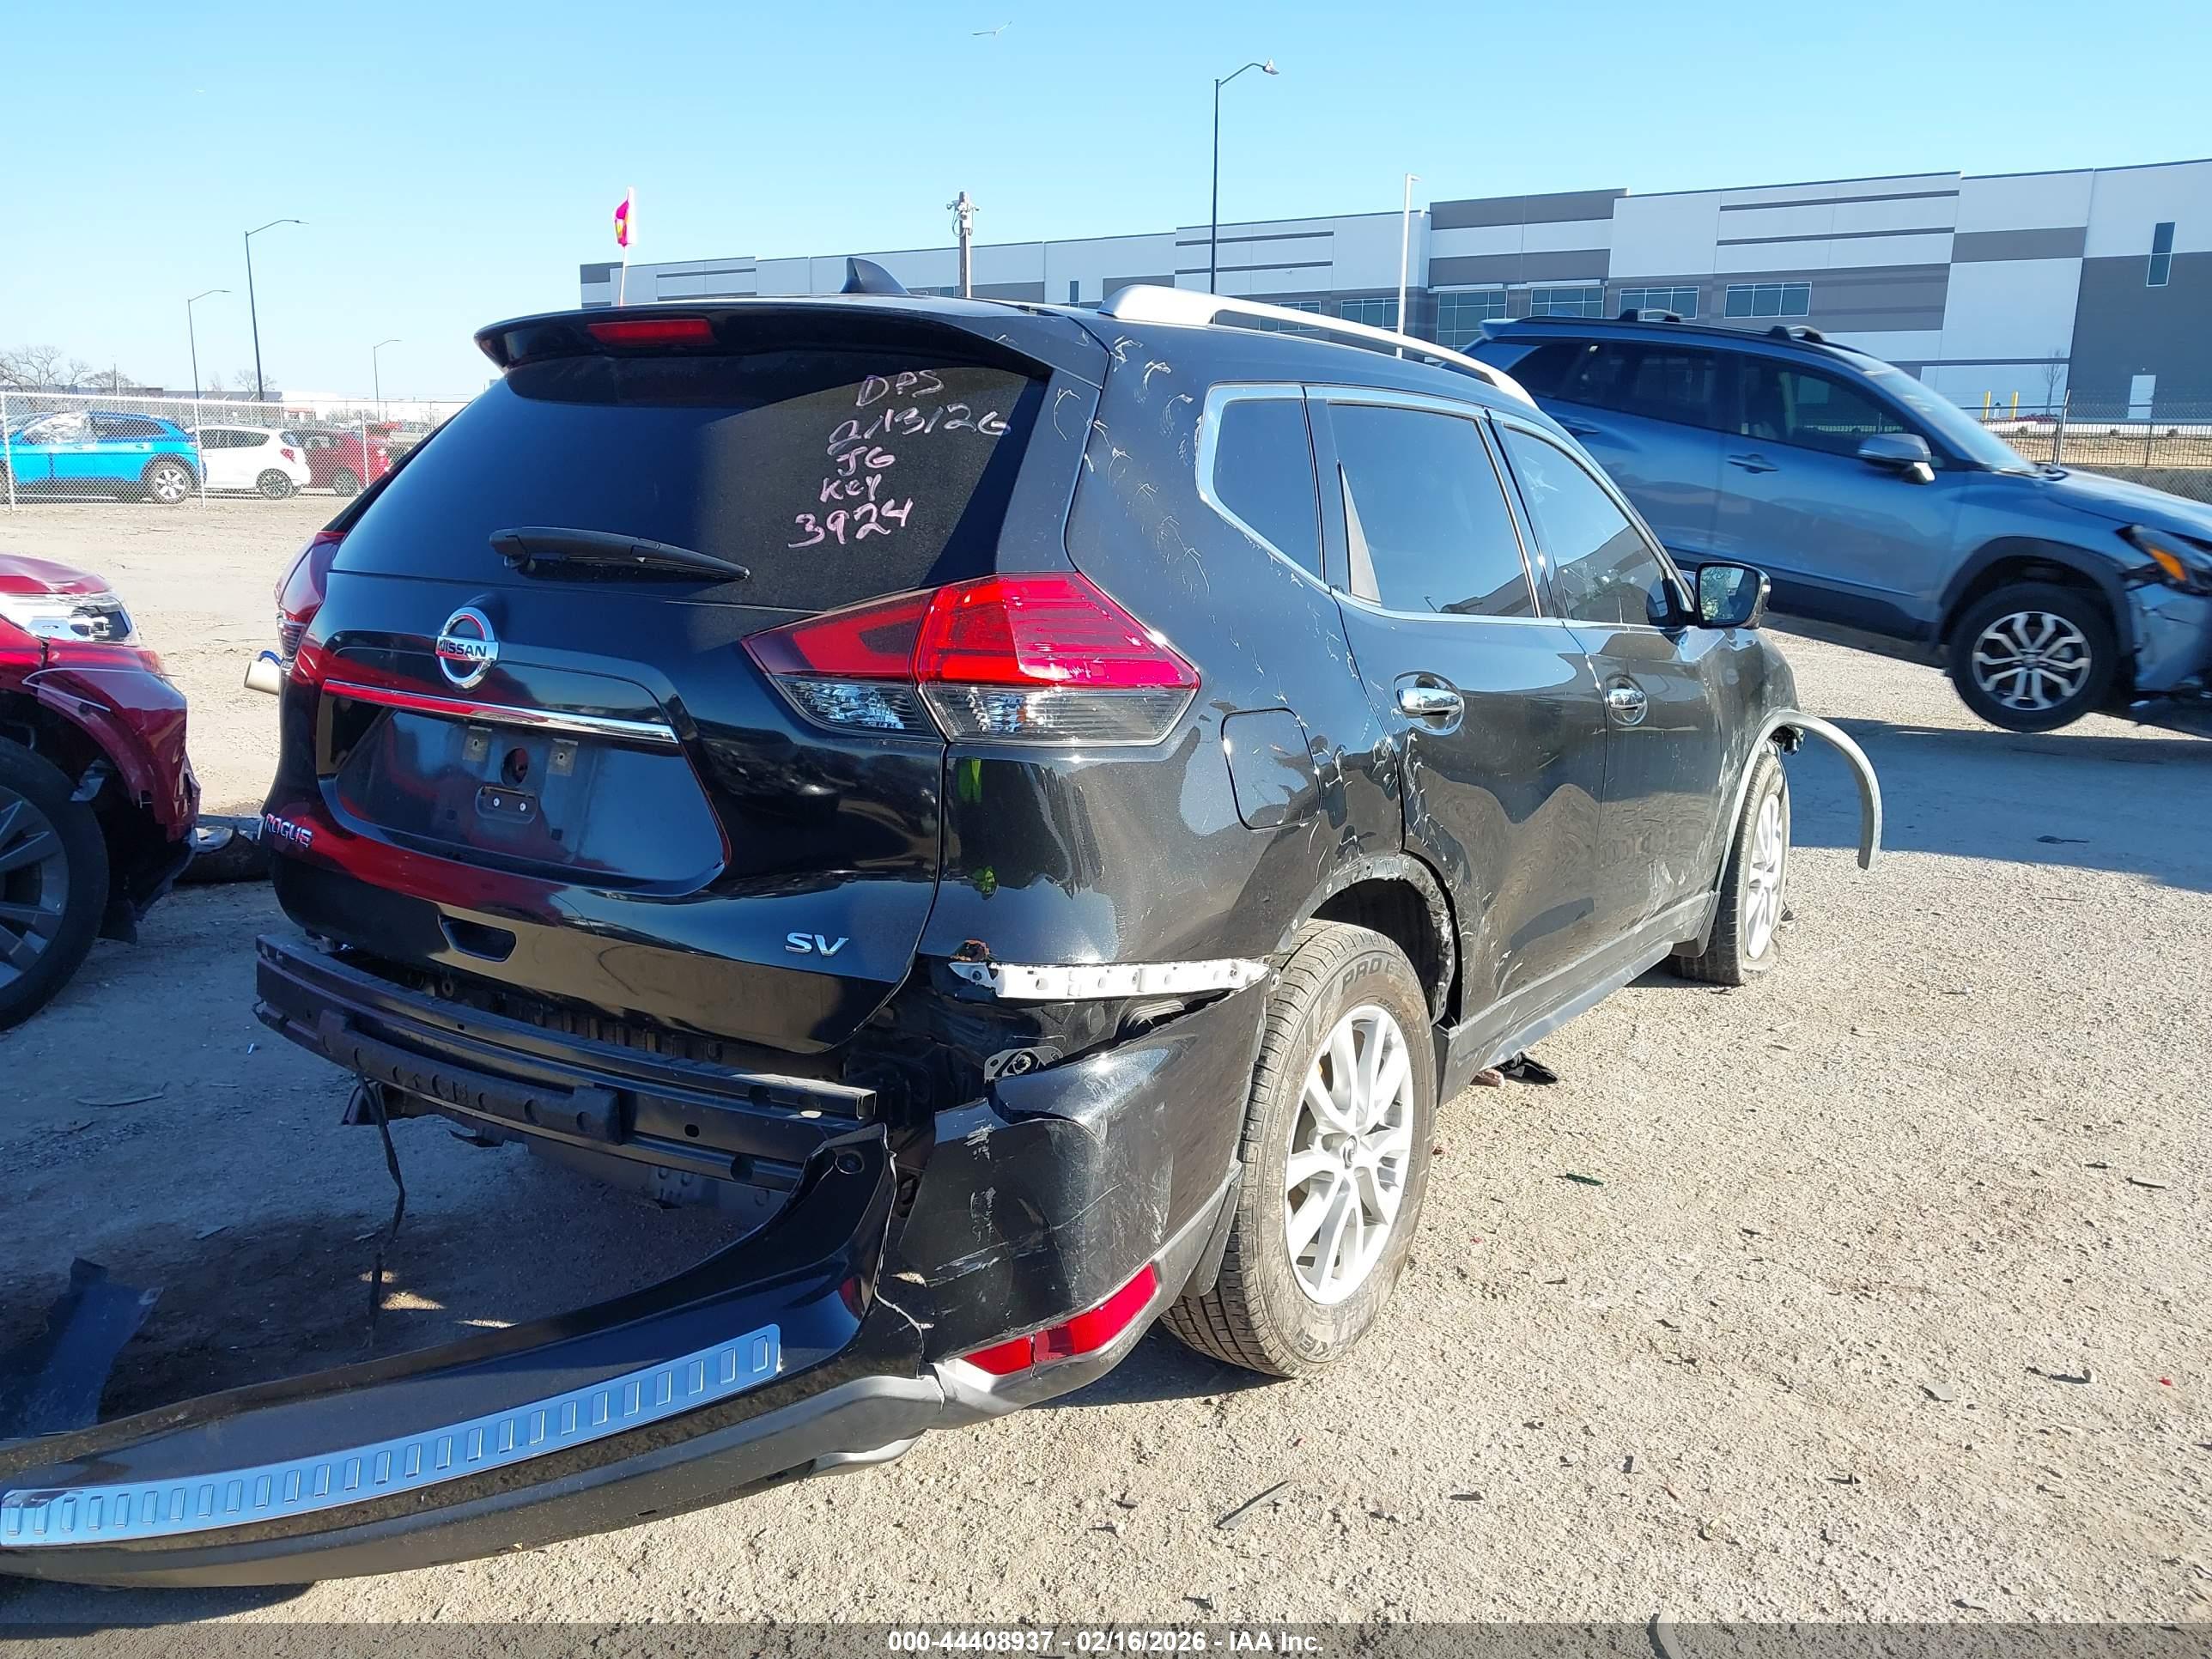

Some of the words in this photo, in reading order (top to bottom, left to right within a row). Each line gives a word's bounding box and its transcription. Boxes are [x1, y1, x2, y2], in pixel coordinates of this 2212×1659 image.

[855, 369, 945, 407] DPS
[826, 402, 1012, 456] 2/13/26
[836, 446, 896, 477] JG
[787, 497, 914, 549] 3924
[437, 638, 488, 658] NISSAN
[264, 812, 313, 848] ROGUE
[784, 932, 850, 957] SV
